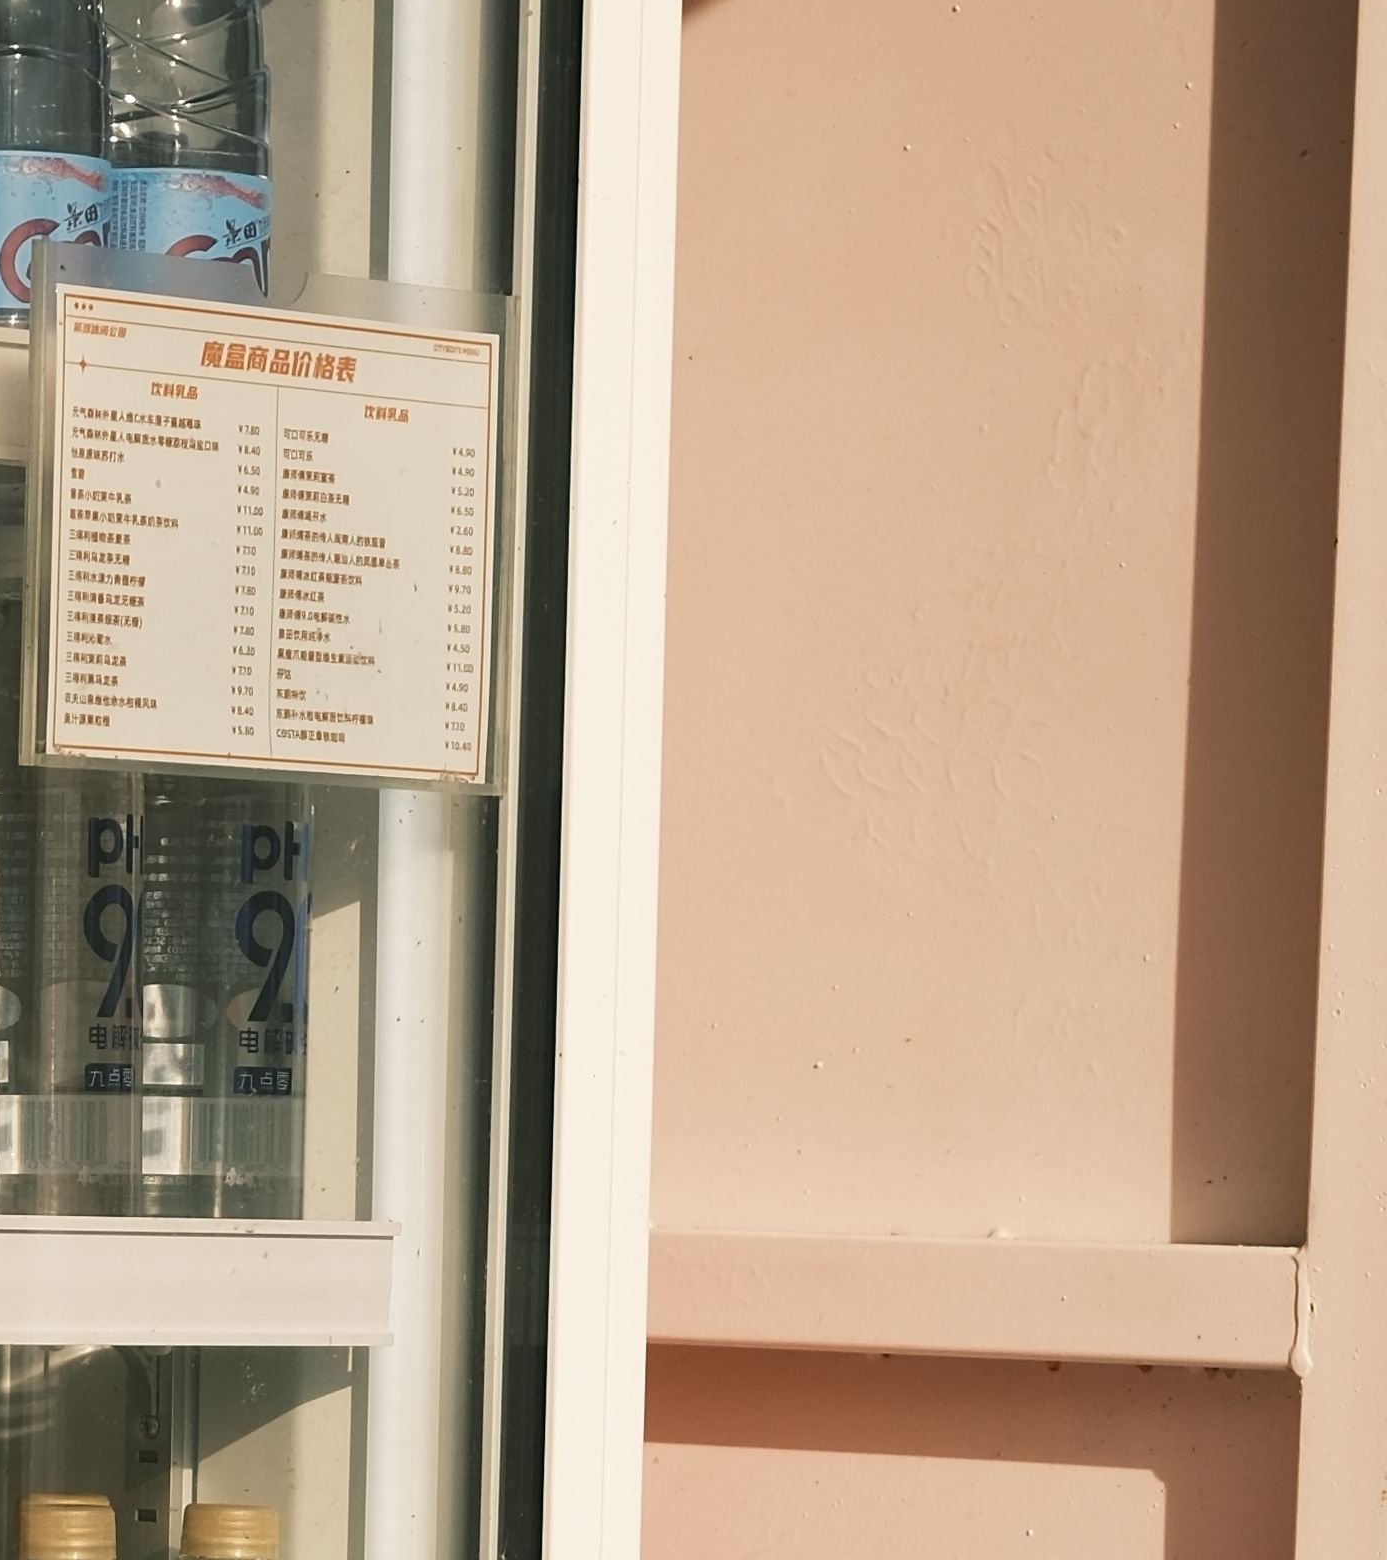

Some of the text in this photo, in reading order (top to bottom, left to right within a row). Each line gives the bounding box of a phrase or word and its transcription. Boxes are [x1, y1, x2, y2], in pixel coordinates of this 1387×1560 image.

[200, 341, 357, 383] 魔盒商品价格表
[151, 382, 198, 400] 饮料乳品
[364, 404, 409, 423] 饮料乳品
[283, 448, 313, 462] 可口可乐
